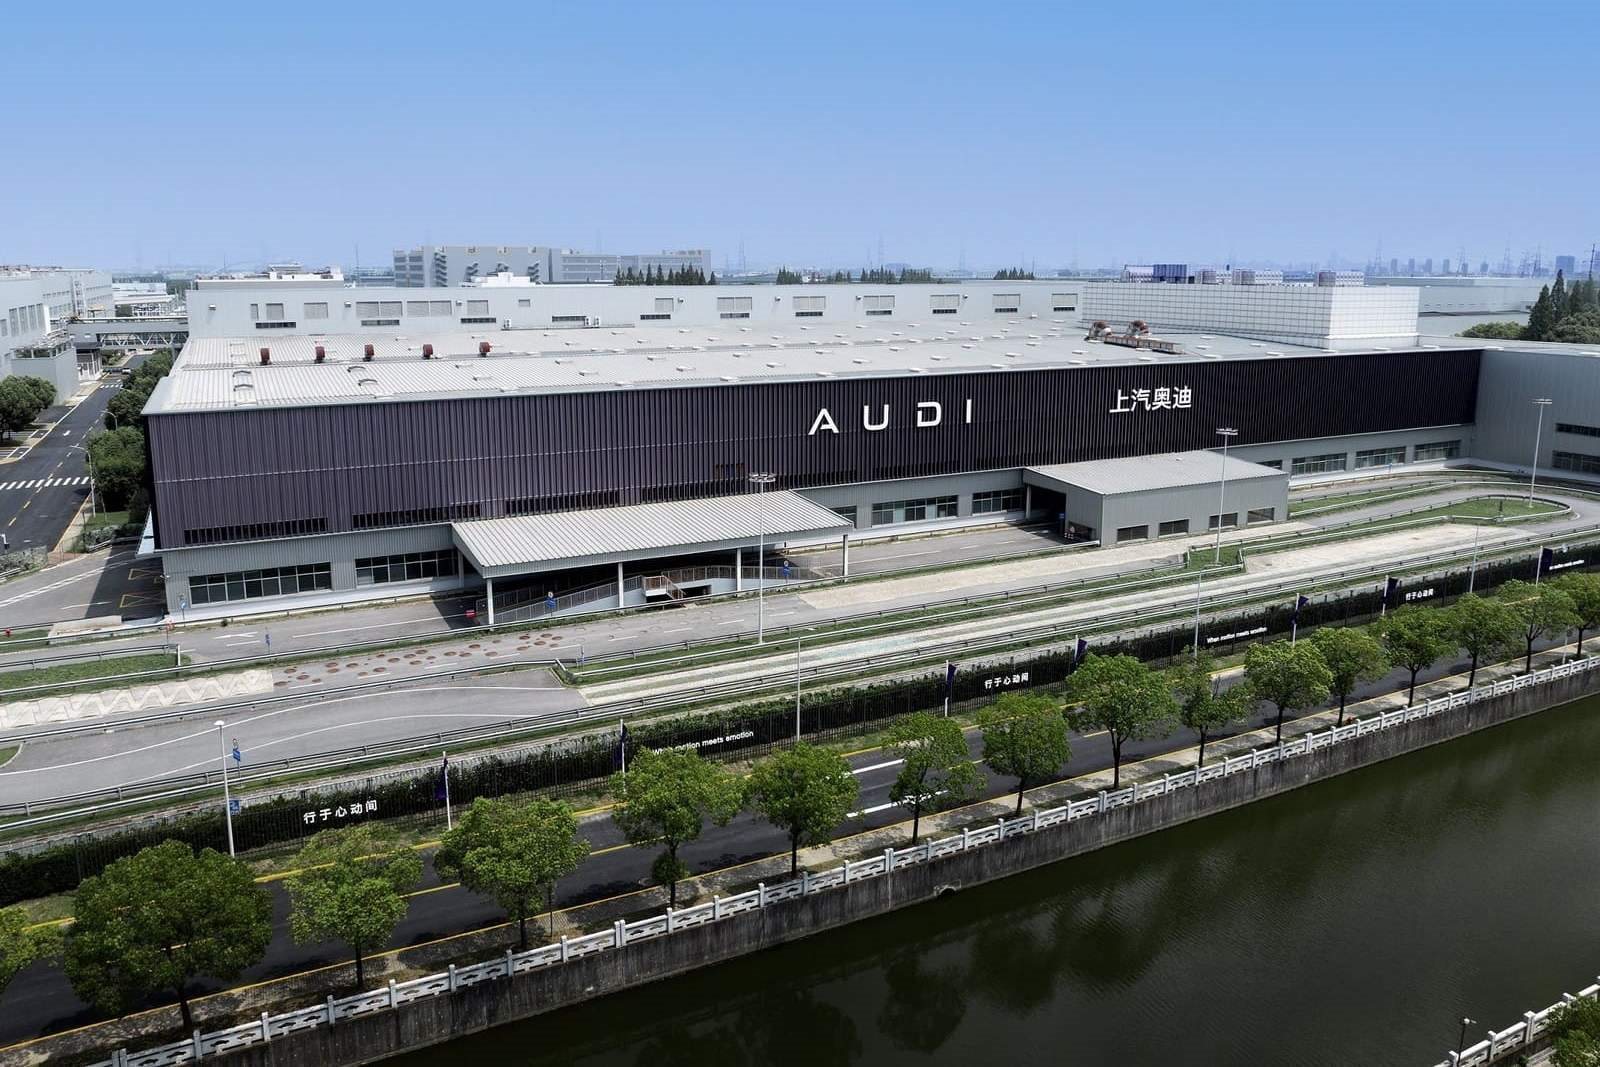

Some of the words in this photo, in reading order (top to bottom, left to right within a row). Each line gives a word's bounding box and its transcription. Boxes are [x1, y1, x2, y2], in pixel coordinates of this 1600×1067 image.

[1109, 385, 1192, 413] 上汽奥迪
[808, 398, 972, 436] AUDI
[702, 737, 724, 746] meets
[725, 731, 754, 740] emotion
[303, 800, 378, 824] 行于心动间
